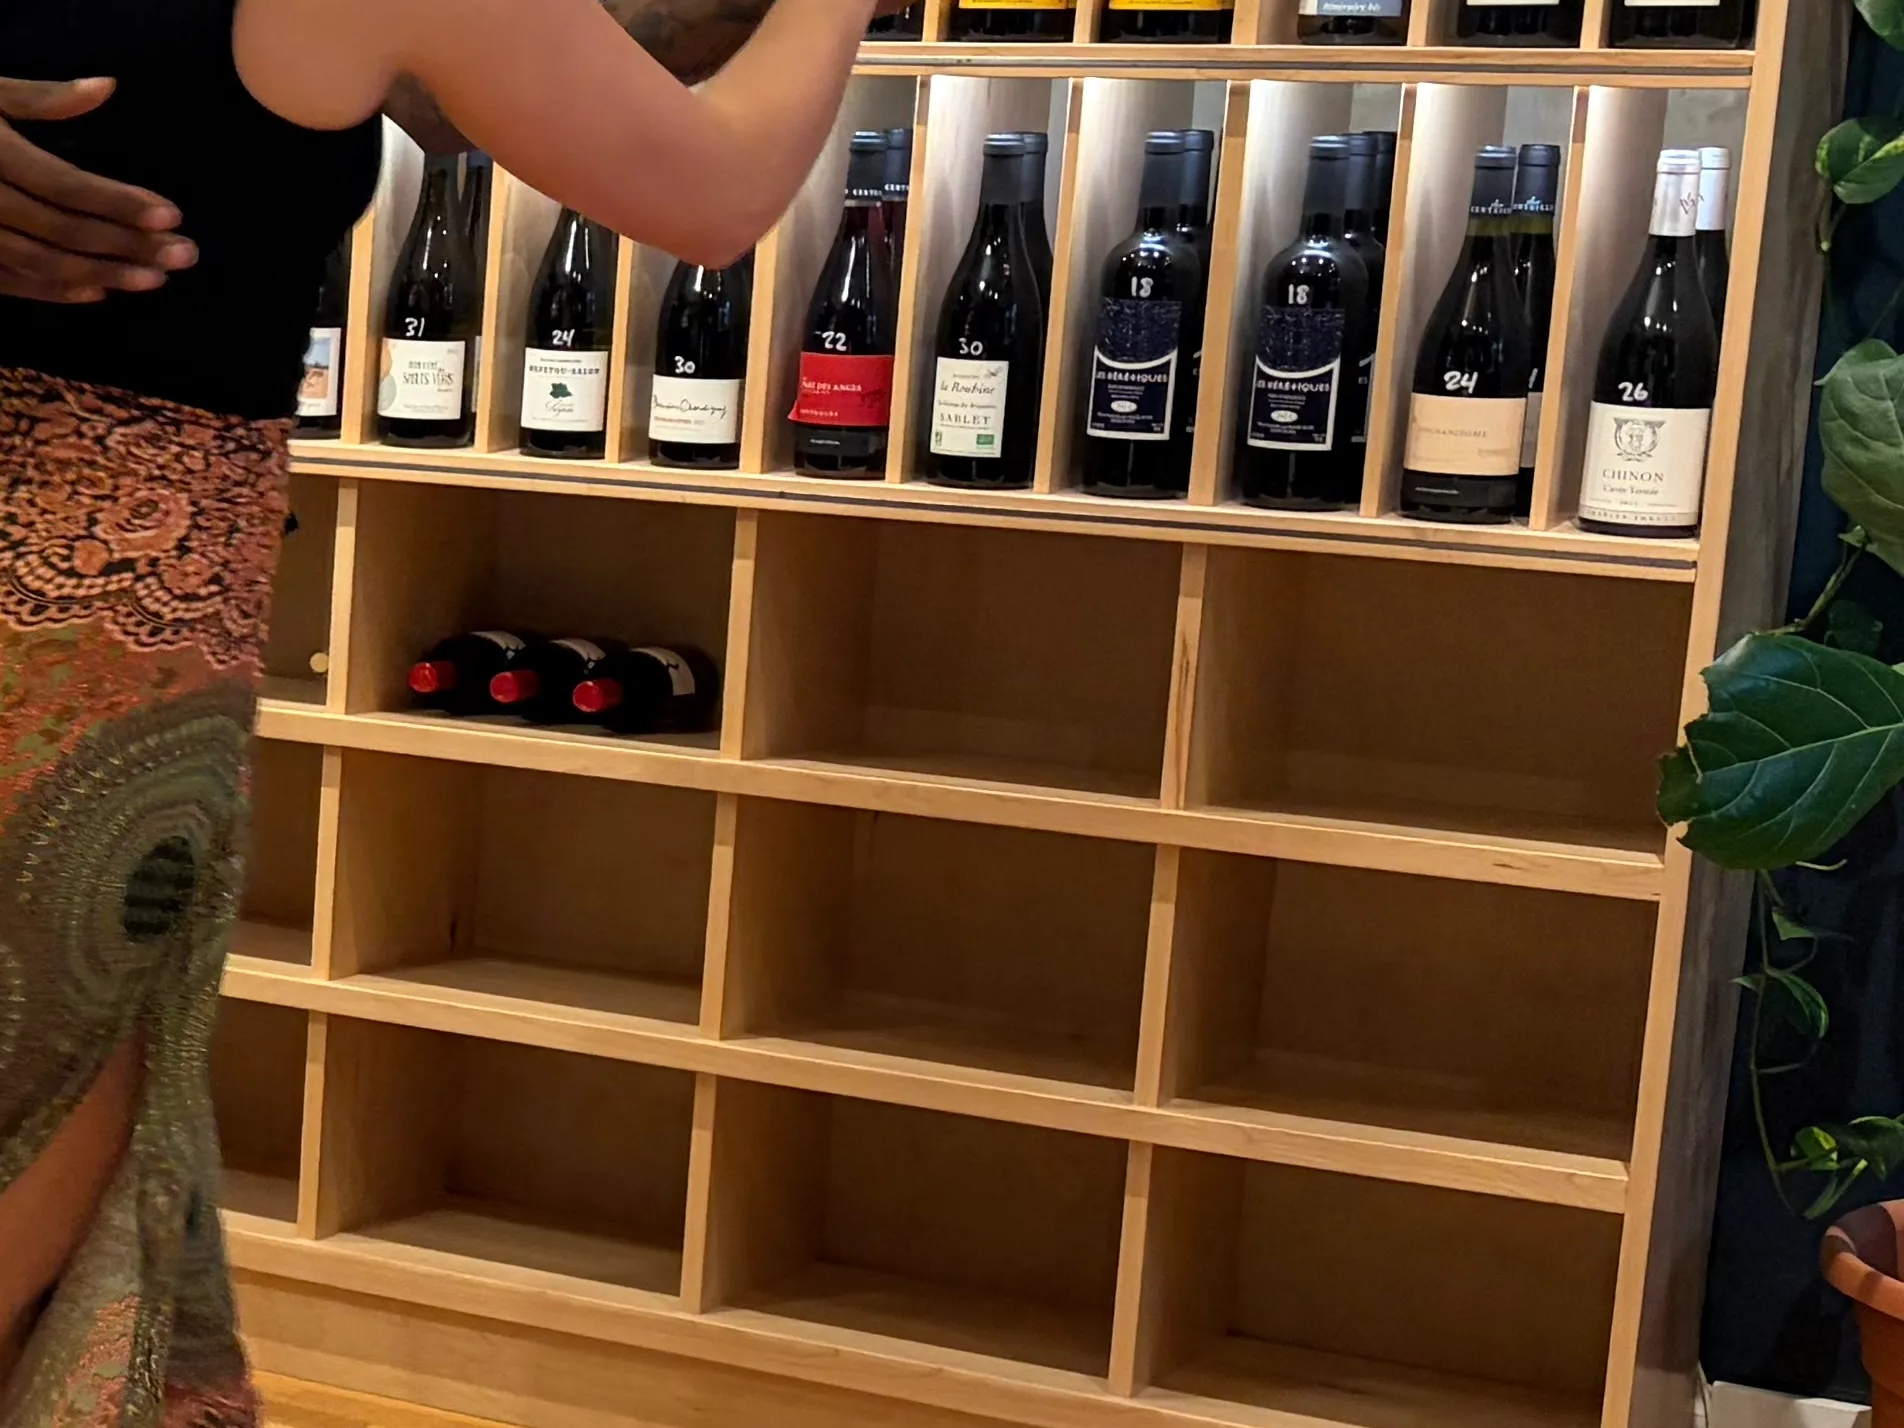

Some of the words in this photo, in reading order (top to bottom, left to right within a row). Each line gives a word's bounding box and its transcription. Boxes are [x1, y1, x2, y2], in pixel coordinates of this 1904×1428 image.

[1131, 276, 1154, 298] 18
[1288, 283, 1310, 305] 18
[404, 317, 425, 338] 31
[551, 328, 576, 347] 24
[958, 337, 983, 356] 30
[674, 355, 696, 374] 30
[1443, 371, 1478, 394] 24
[1618, 381, 1649, 402] 26
[1602, 469, 1664, 482] CHINON
